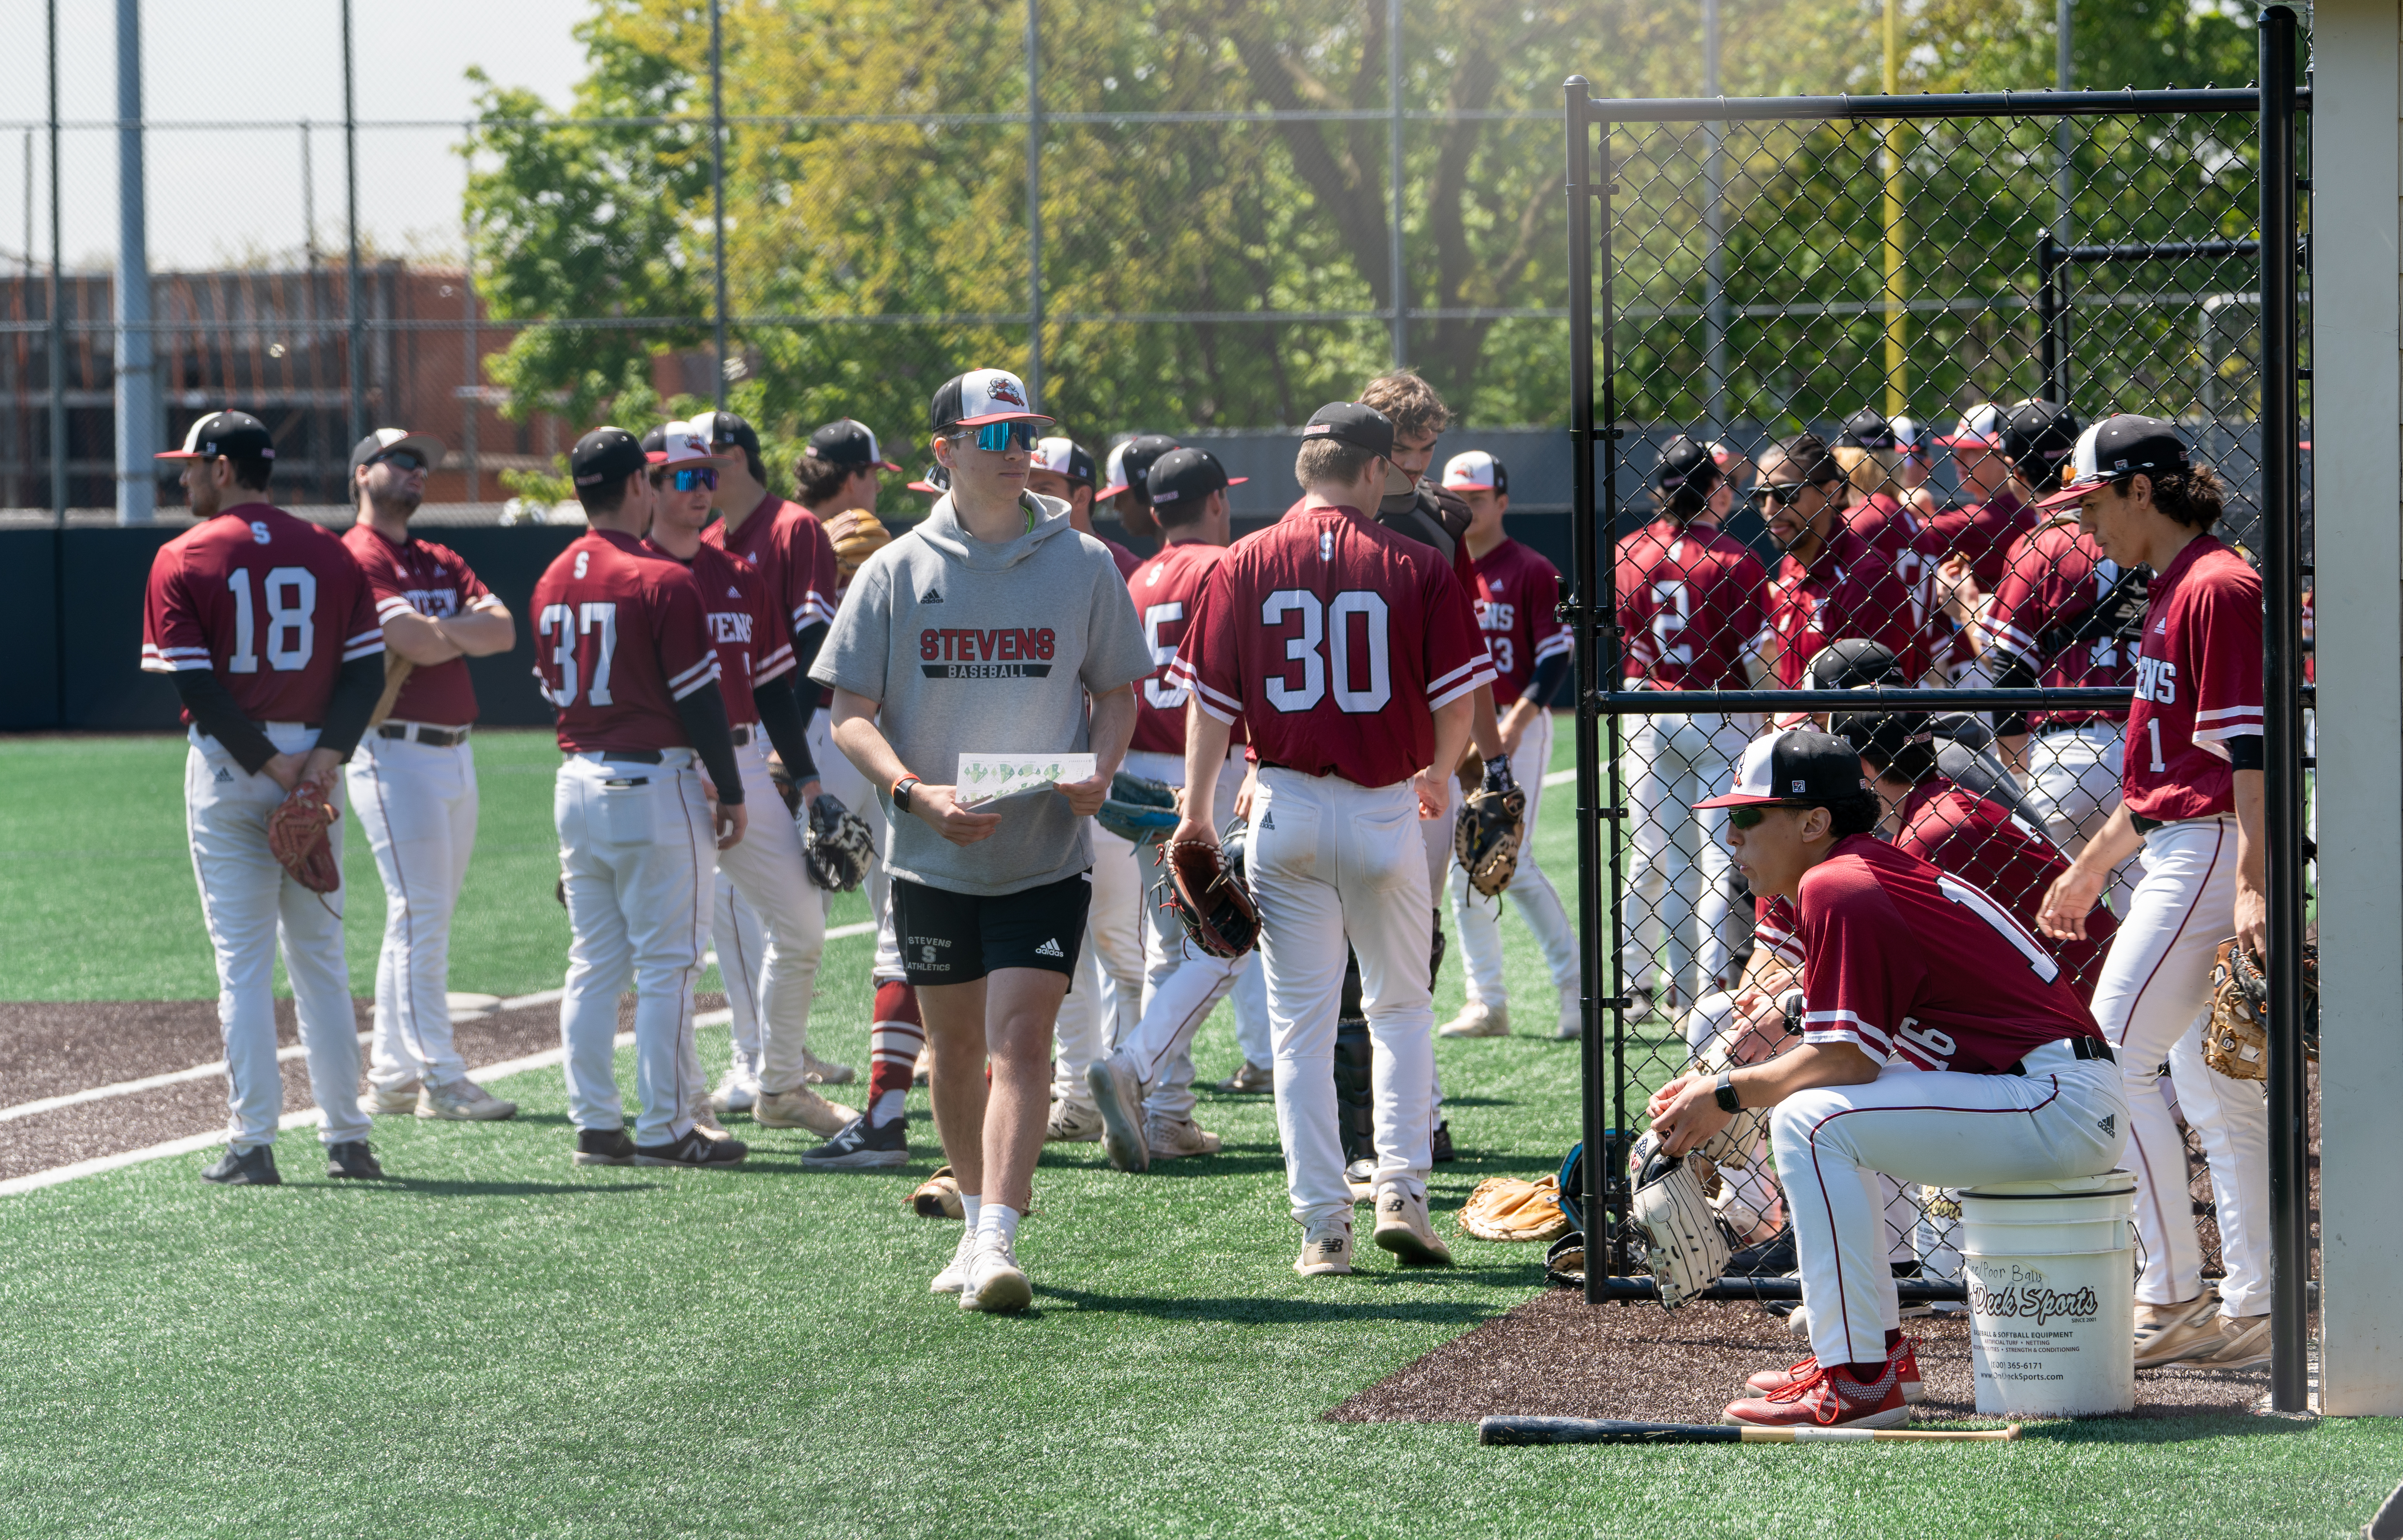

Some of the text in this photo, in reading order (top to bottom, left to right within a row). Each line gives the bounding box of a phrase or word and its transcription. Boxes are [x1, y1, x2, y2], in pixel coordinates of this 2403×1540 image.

[250, 521, 271, 544] S
[1320, 530, 1335, 560] S
[573, 551, 590, 579] S
[1146, 562, 1165, 587] S
[227, 566, 317, 673] 18
[1651, 580, 1693, 665] 2
[539, 602, 618, 707] 37
[920, 628, 1056, 661] STEVENS
[1134, 601, 1190, 710] 5
[1261, 587, 1392, 714] 30
[949, 664, 1027, 678] BASEBALL
[2147, 716, 2166, 773] 1
[908, 936, 952, 948] STEVENS
[922, 945, 936, 964] S
[1036, 948, 1064, 957] adidas
[907, 962, 951, 971] ATHLETICS
[1892, 1017, 1957, 1072] 16
[2097, 1121, 2116, 1139] adidas
[2012, 1265, 2042, 1282] Balls
[1973, 1282, 2018, 1318] Deck
[2019, 1280, 2098, 1326] Sports
[1980, 1372, 2064, 1382] wwwOnDeckSports.com
